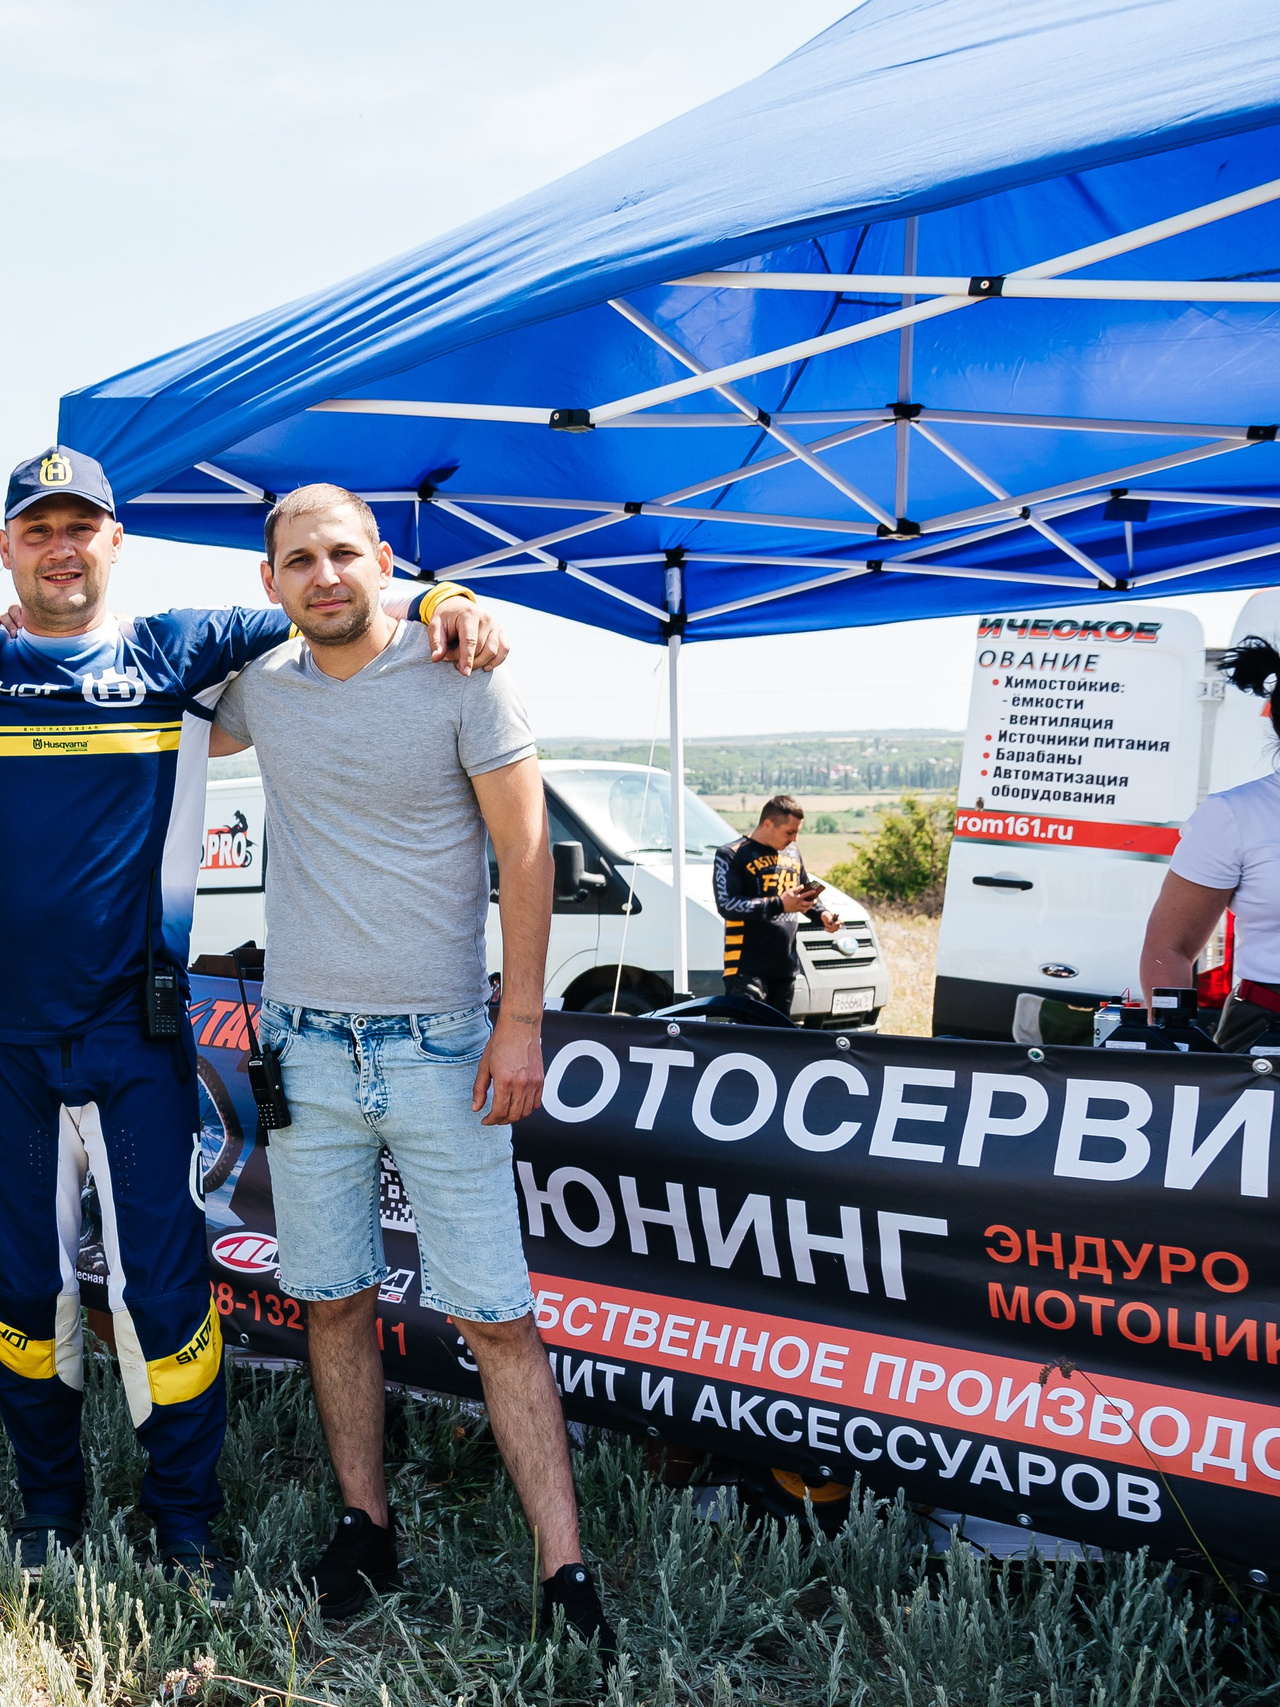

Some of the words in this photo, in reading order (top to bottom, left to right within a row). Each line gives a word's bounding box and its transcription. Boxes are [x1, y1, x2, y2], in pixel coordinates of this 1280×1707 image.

[978, 650, 1100, 673] ОВАНИЕ
[1004, 675, 1126, 693] Химостойкие:
[1009, 714, 1114, 730] вентиляция
[43, 740, 88, 750] Husqvarna
[998, 729, 1090, 748] Источники
[1093, 736, 1170, 753] питания
[995, 748, 1083, 766] Барабаны
[992, 766, 1129, 788] Автоматизация
[991, 785, 1116, 805] оборудования
[954, 815, 1074, 841] rom161.ru
[516, 1161, 948, 1300] ЮНИНГ
[983, 1224, 1249, 1293] ЭНДУРО
[74, 1268, 104, 1285] есная
[210, 1281, 305, 1331] 8-132
[641, 1372, 674, 1416] И
[692, 1386, 1161, 1523] АКСЕССУАРОВ
